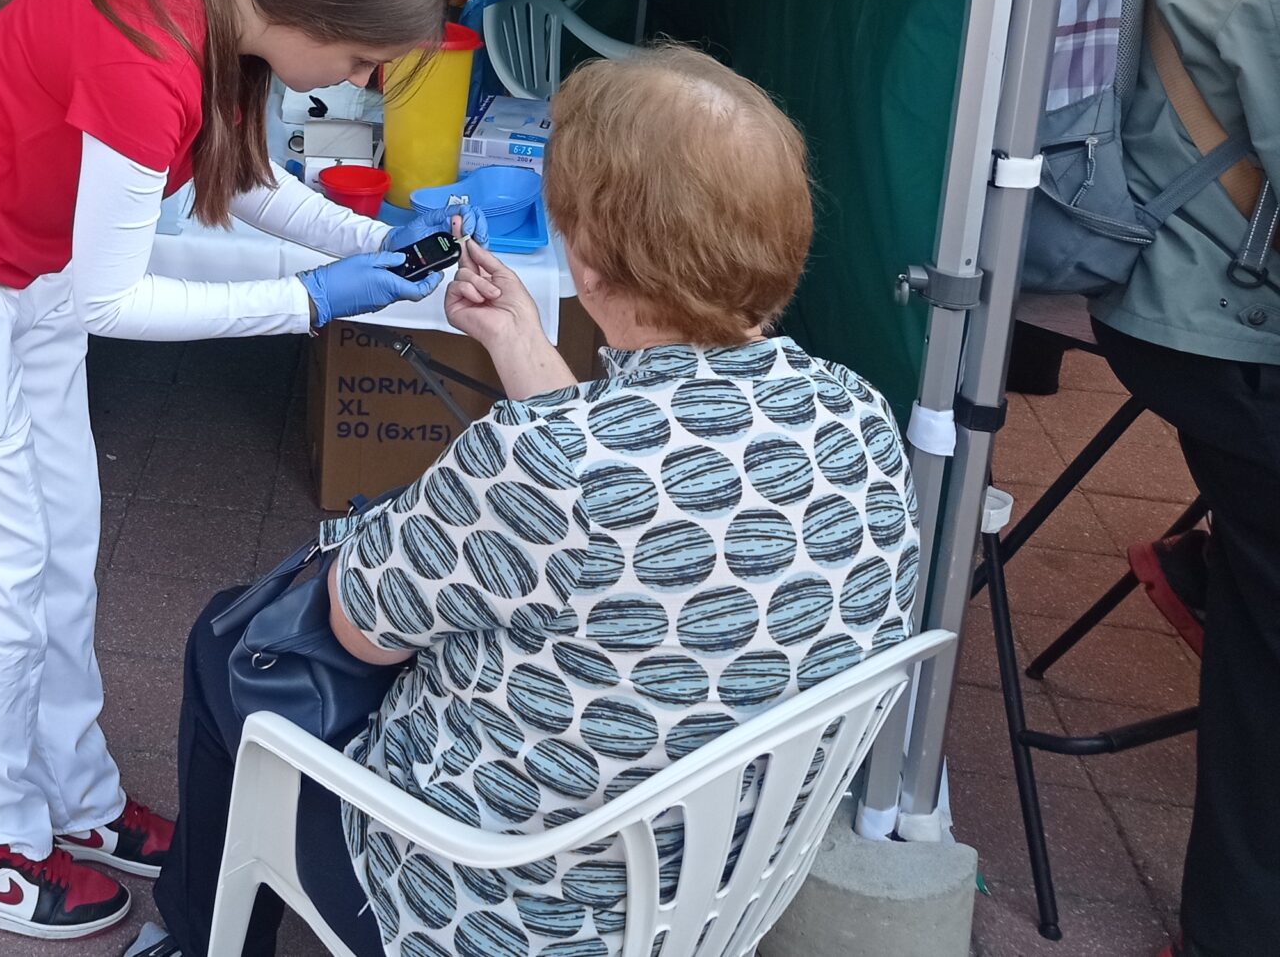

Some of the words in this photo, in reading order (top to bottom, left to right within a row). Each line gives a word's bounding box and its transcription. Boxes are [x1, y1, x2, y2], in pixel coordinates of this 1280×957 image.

[337, 398, 369, 416] XL
[337, 421, 369, 439] 90
[377, 422, 451, 444] (6x15)
